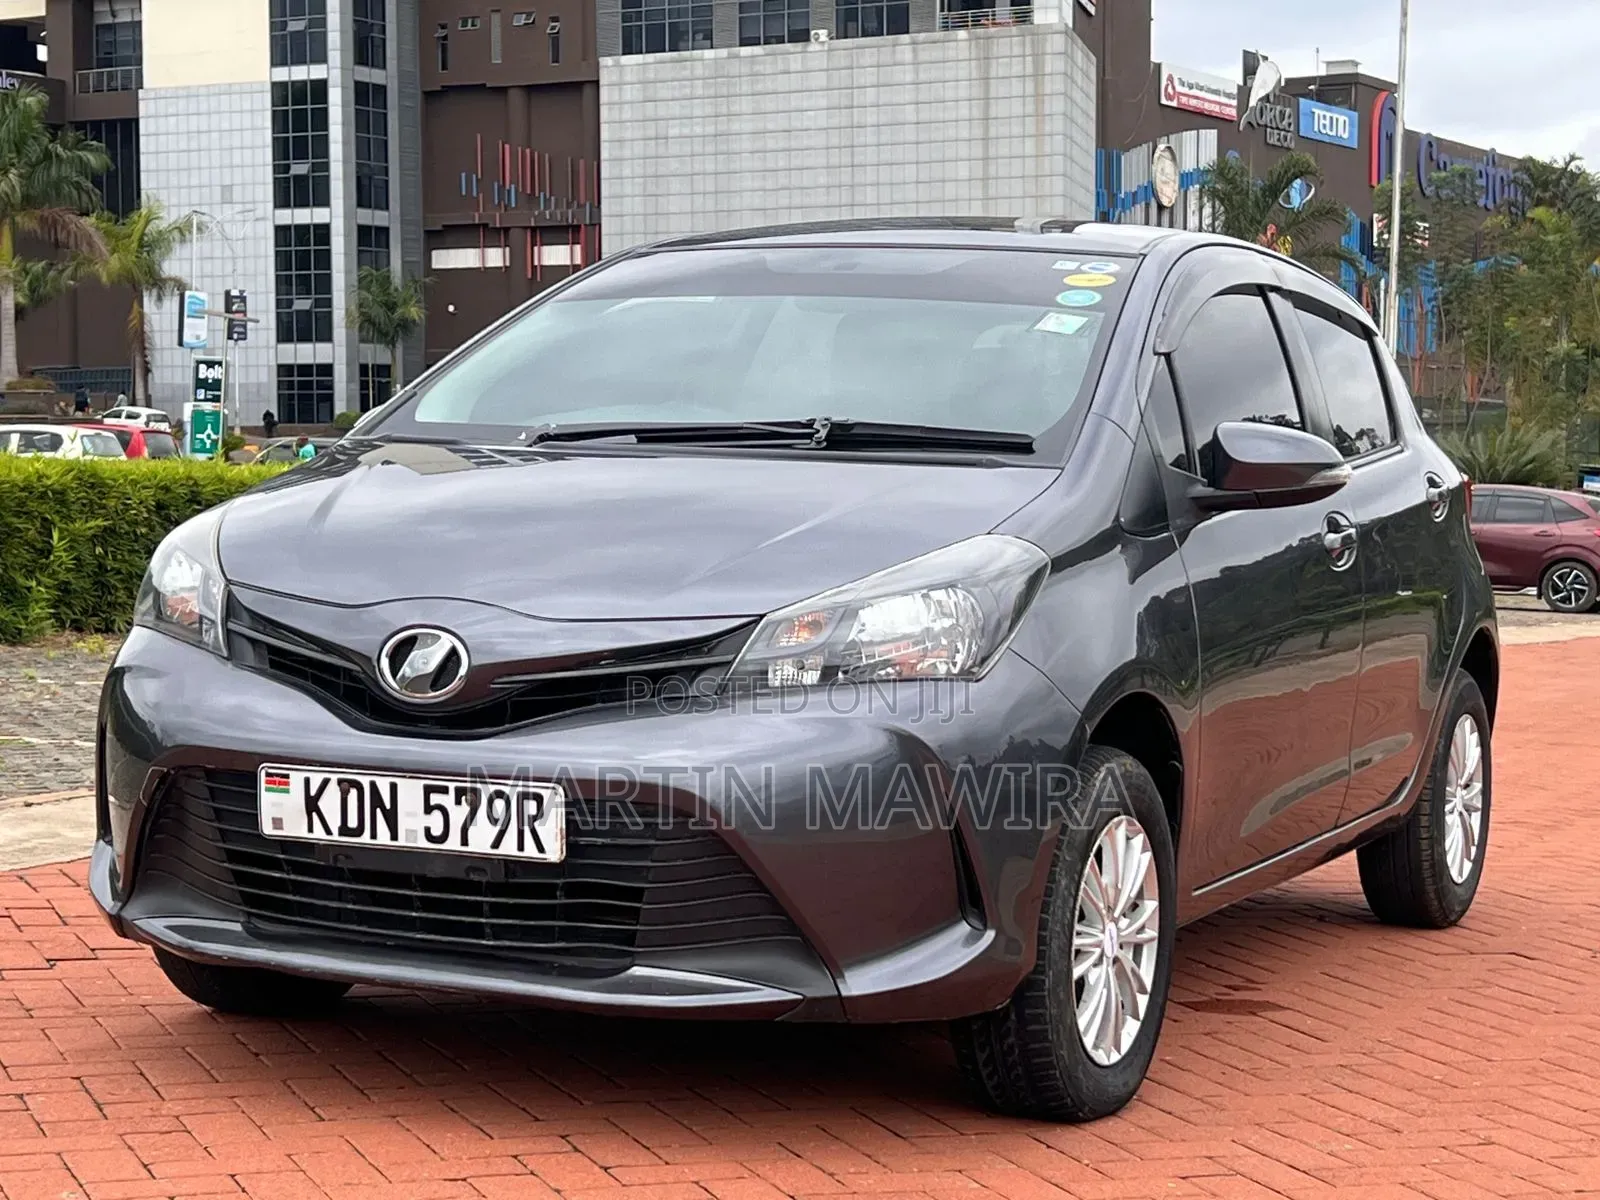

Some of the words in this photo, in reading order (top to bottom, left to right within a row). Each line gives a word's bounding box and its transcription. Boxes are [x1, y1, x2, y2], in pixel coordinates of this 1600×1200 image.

[1311, 108, 1349, 139] TECNO
[198, 363, 223, 383] Bolt
[303, 776, 399, 842] KDN
[423, 783, 546, 854] 579R
